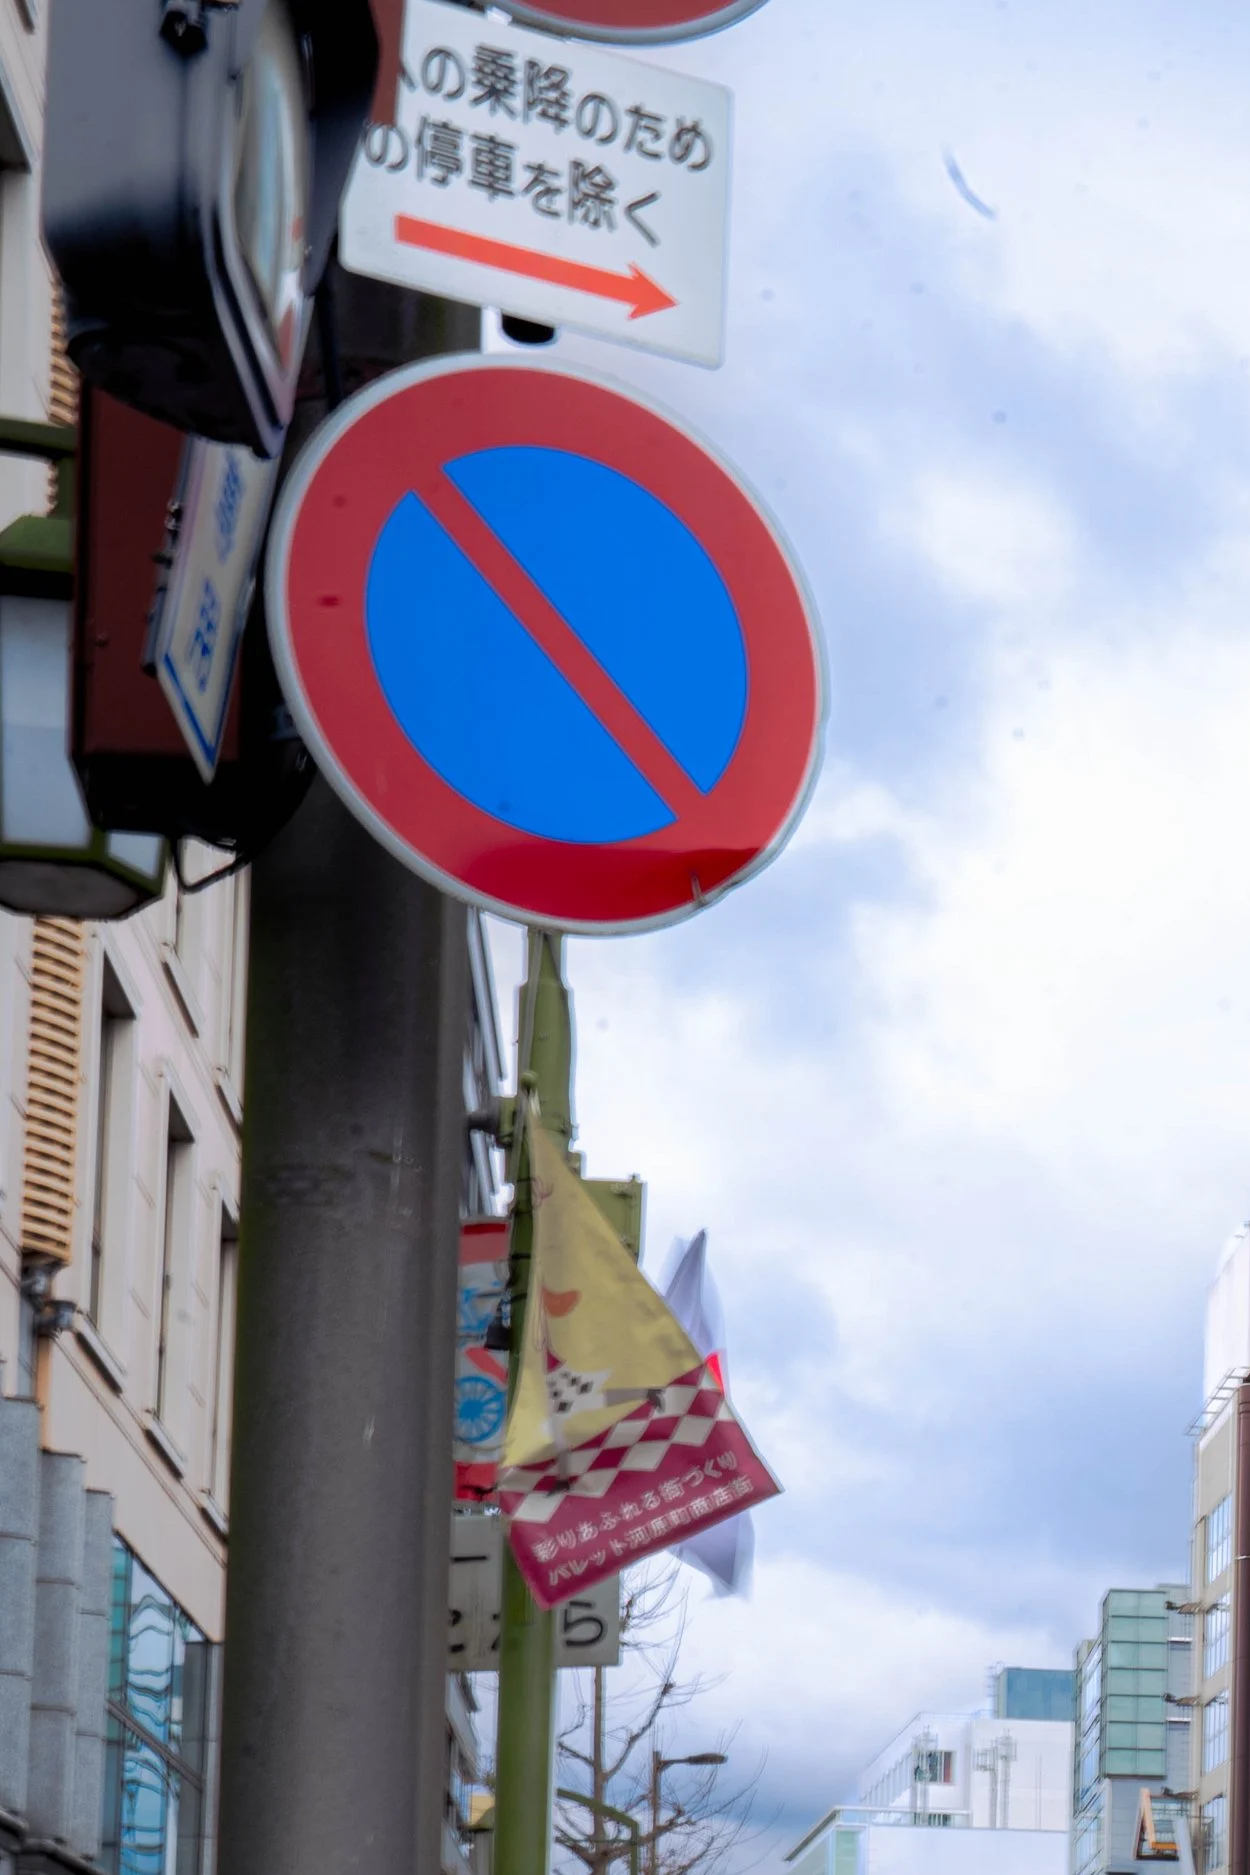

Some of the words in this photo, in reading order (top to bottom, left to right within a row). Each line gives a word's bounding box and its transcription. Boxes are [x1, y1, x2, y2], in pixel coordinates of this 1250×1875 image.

[402, 43, 713, 172] の乗降のため
